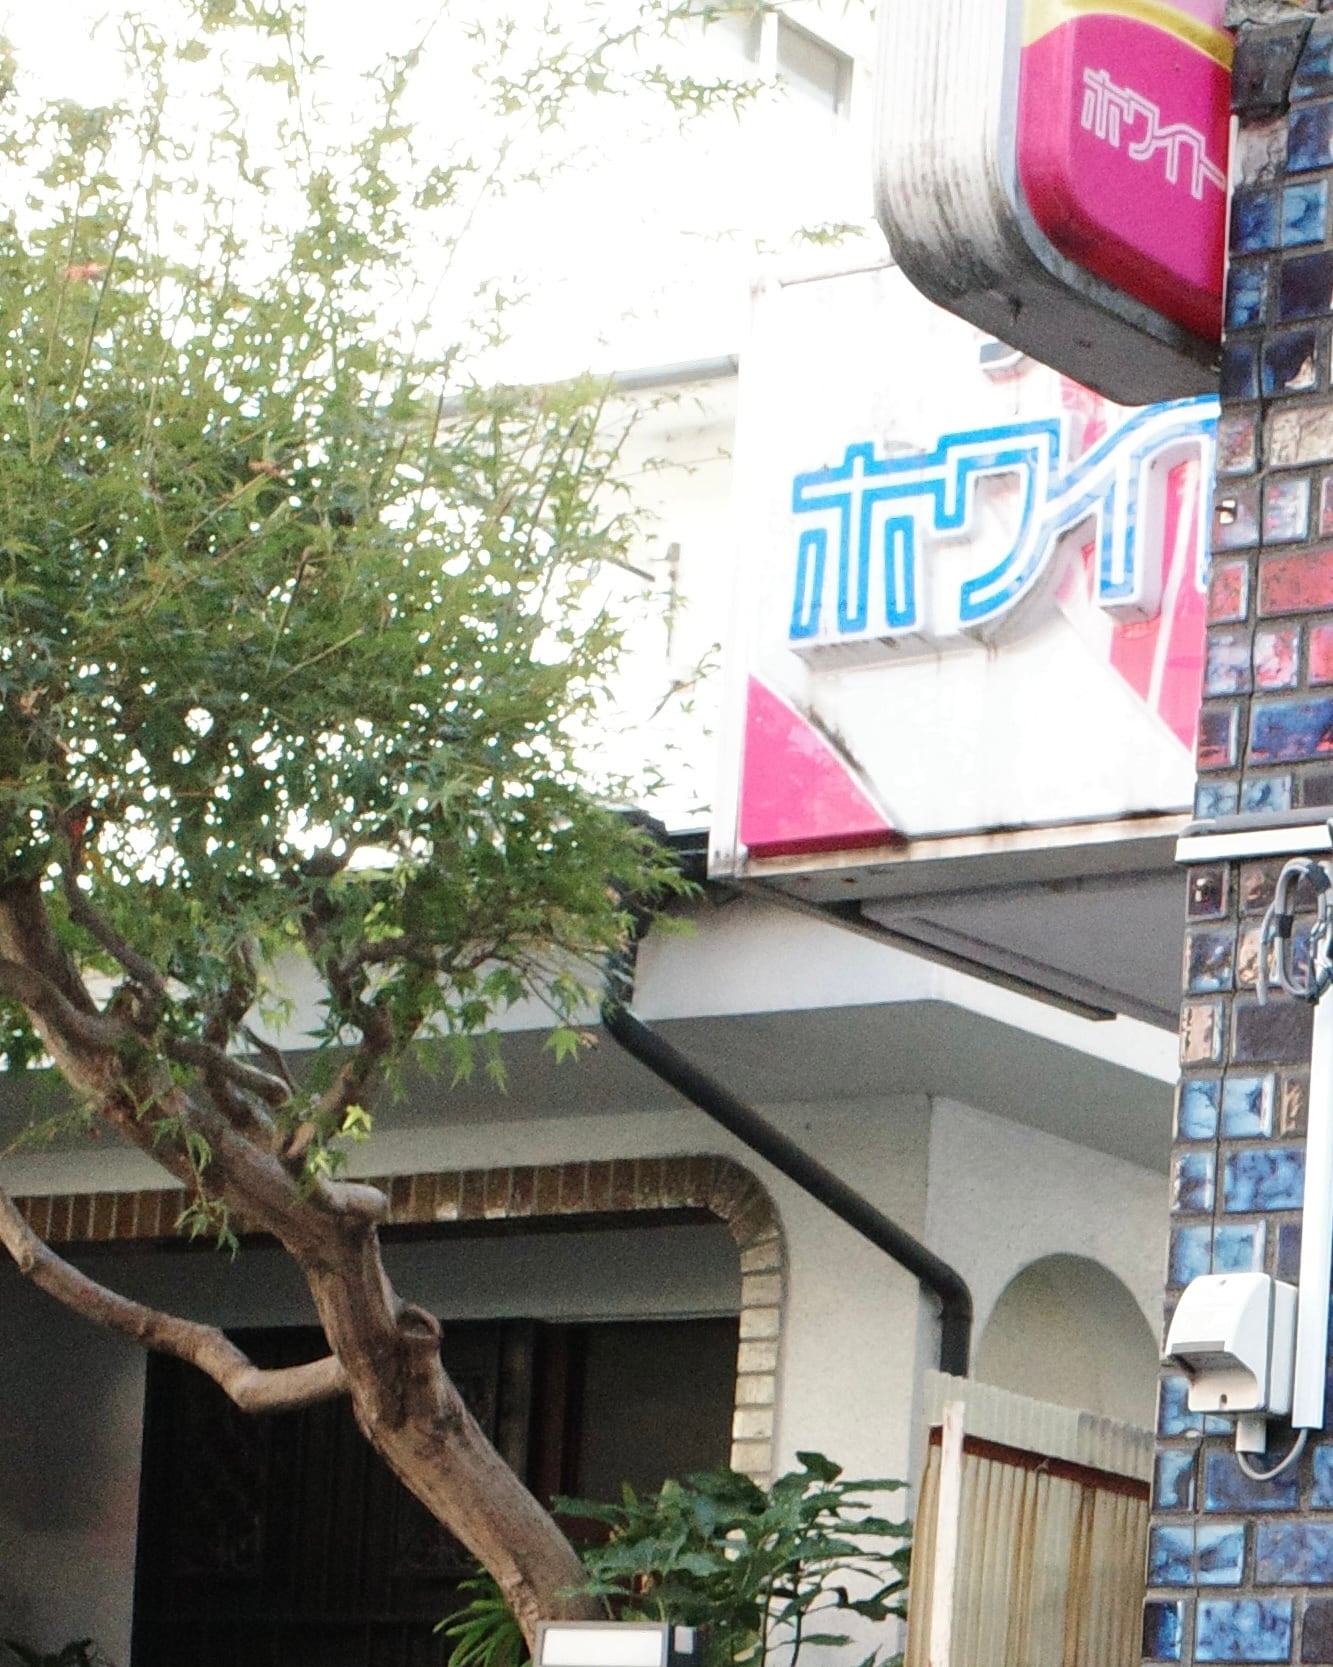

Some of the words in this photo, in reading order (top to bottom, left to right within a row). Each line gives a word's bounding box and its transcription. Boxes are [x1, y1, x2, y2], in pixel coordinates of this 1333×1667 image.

[1081, 66, 1227, 200] ホワイト
[789, 391, 1220, 640] ホワイ
